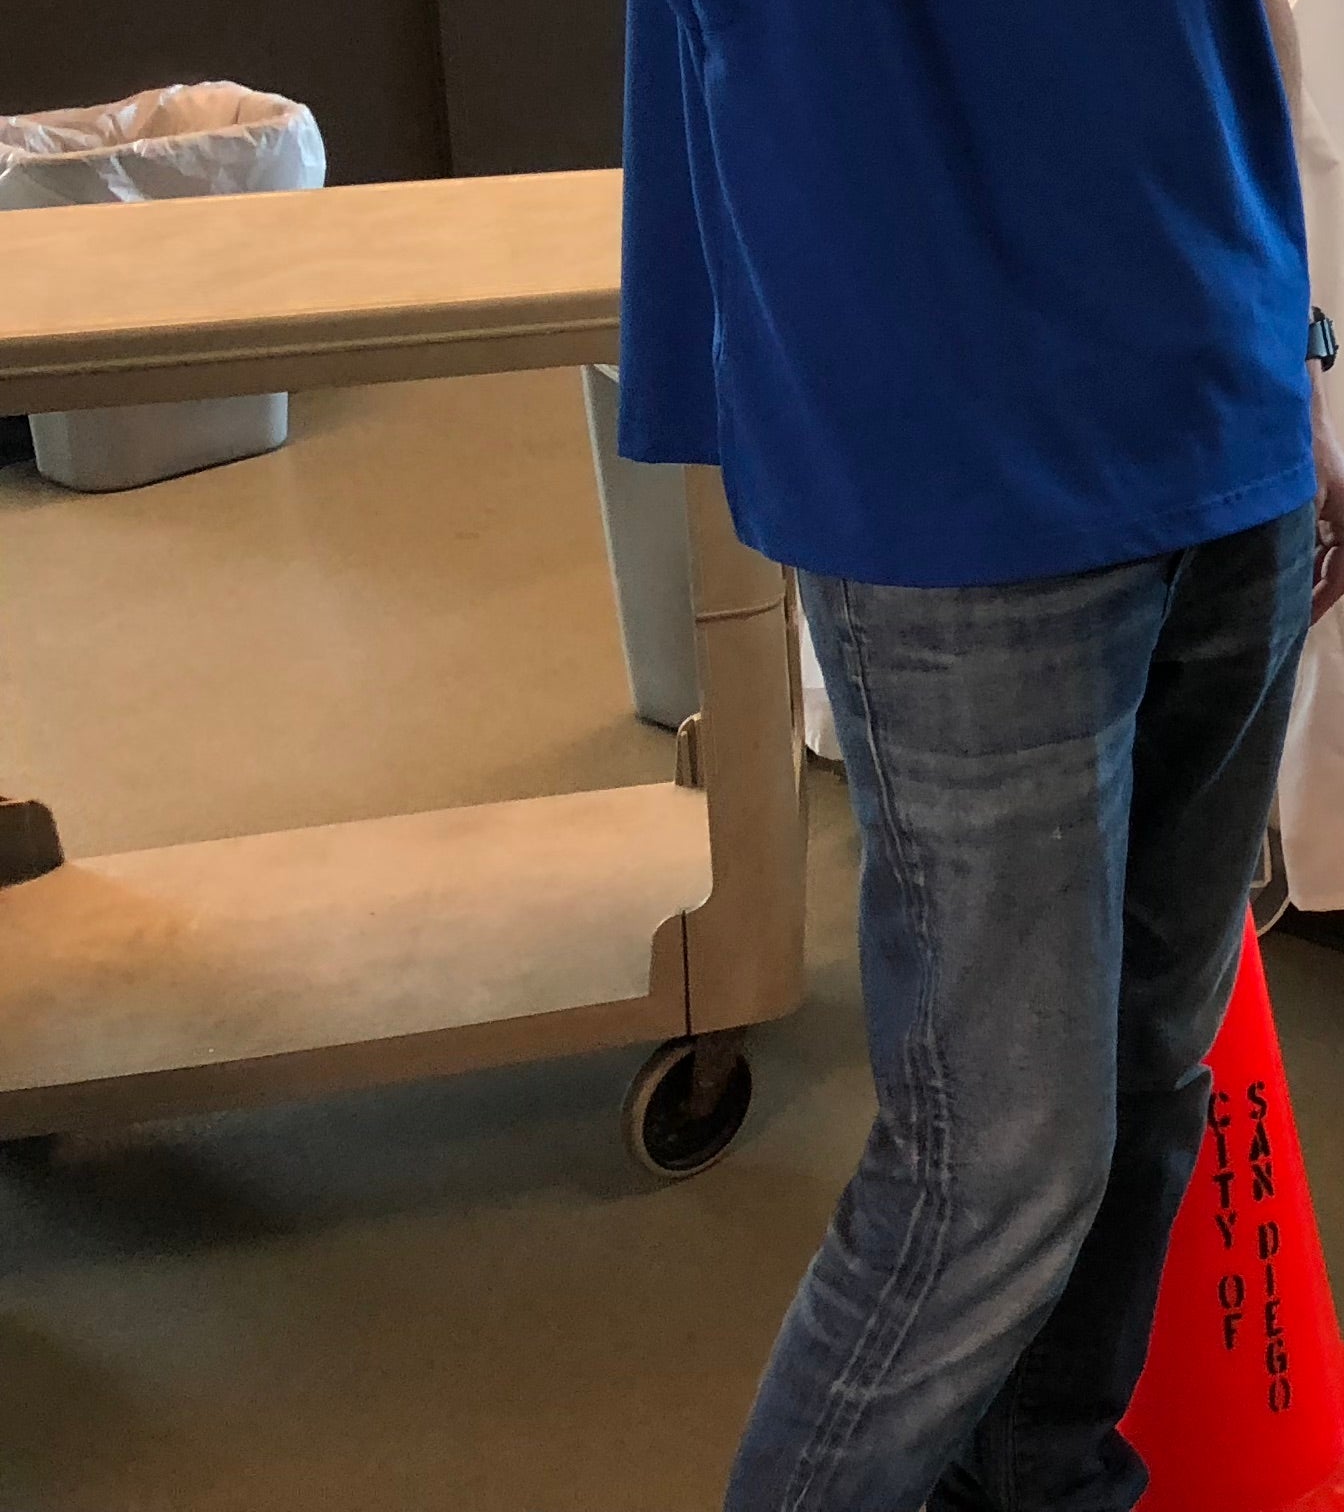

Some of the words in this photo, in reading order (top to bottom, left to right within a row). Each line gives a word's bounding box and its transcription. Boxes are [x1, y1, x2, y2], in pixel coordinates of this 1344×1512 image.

[1206, 1091, 1238, 1250] CITY
[1246, 1080, 1275, 1202] SAN
[1216, 1274, 1246, 1350] OF
[1256, 1220, 1292, 1413] DIEGO
